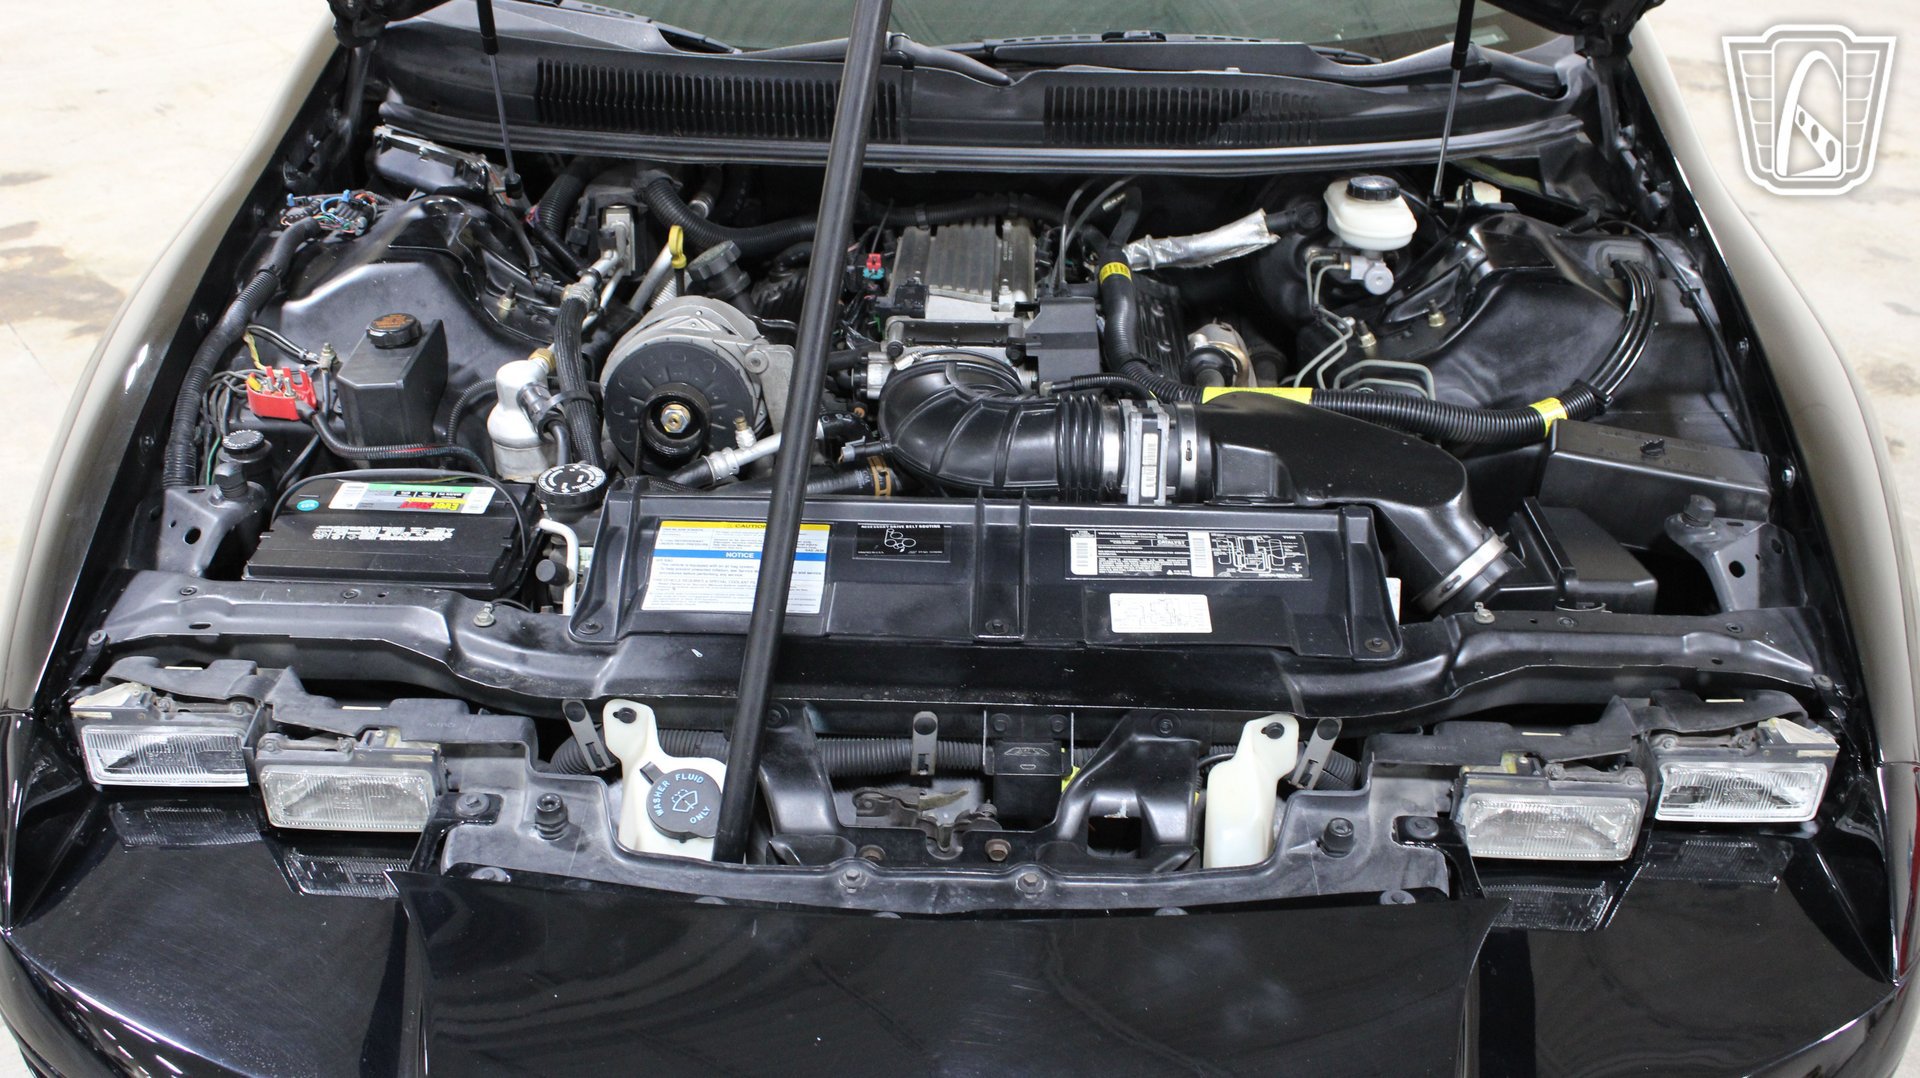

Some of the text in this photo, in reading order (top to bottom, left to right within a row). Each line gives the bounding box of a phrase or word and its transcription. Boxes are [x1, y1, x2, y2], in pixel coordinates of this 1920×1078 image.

[653, 773, 703, 816] WASHER FLUID
[690, 806, 711, 823] ONLY
